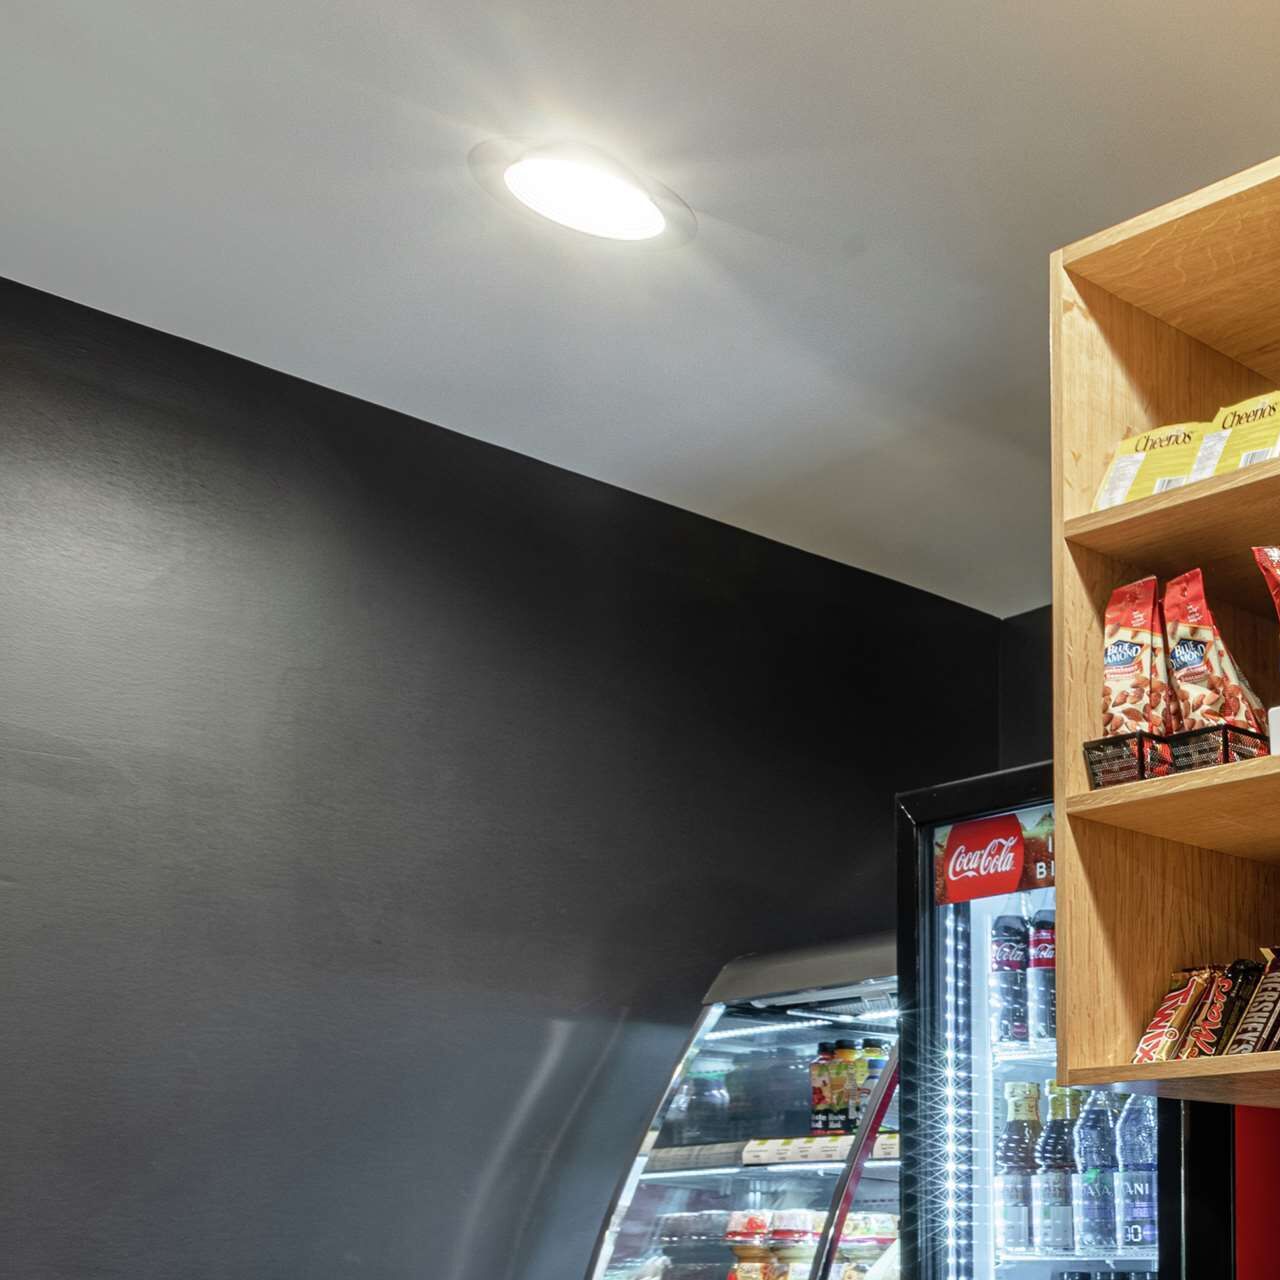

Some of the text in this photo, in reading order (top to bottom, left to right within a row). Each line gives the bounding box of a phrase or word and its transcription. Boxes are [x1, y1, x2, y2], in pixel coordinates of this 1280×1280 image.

[1221, 400, 1279, 431] Cheerios
[1134, 430, 1194, 453] Cheerios
[1176, 640, 1196, 655] BLUE
[948, 836, 1017, 881] Coca-Cola
